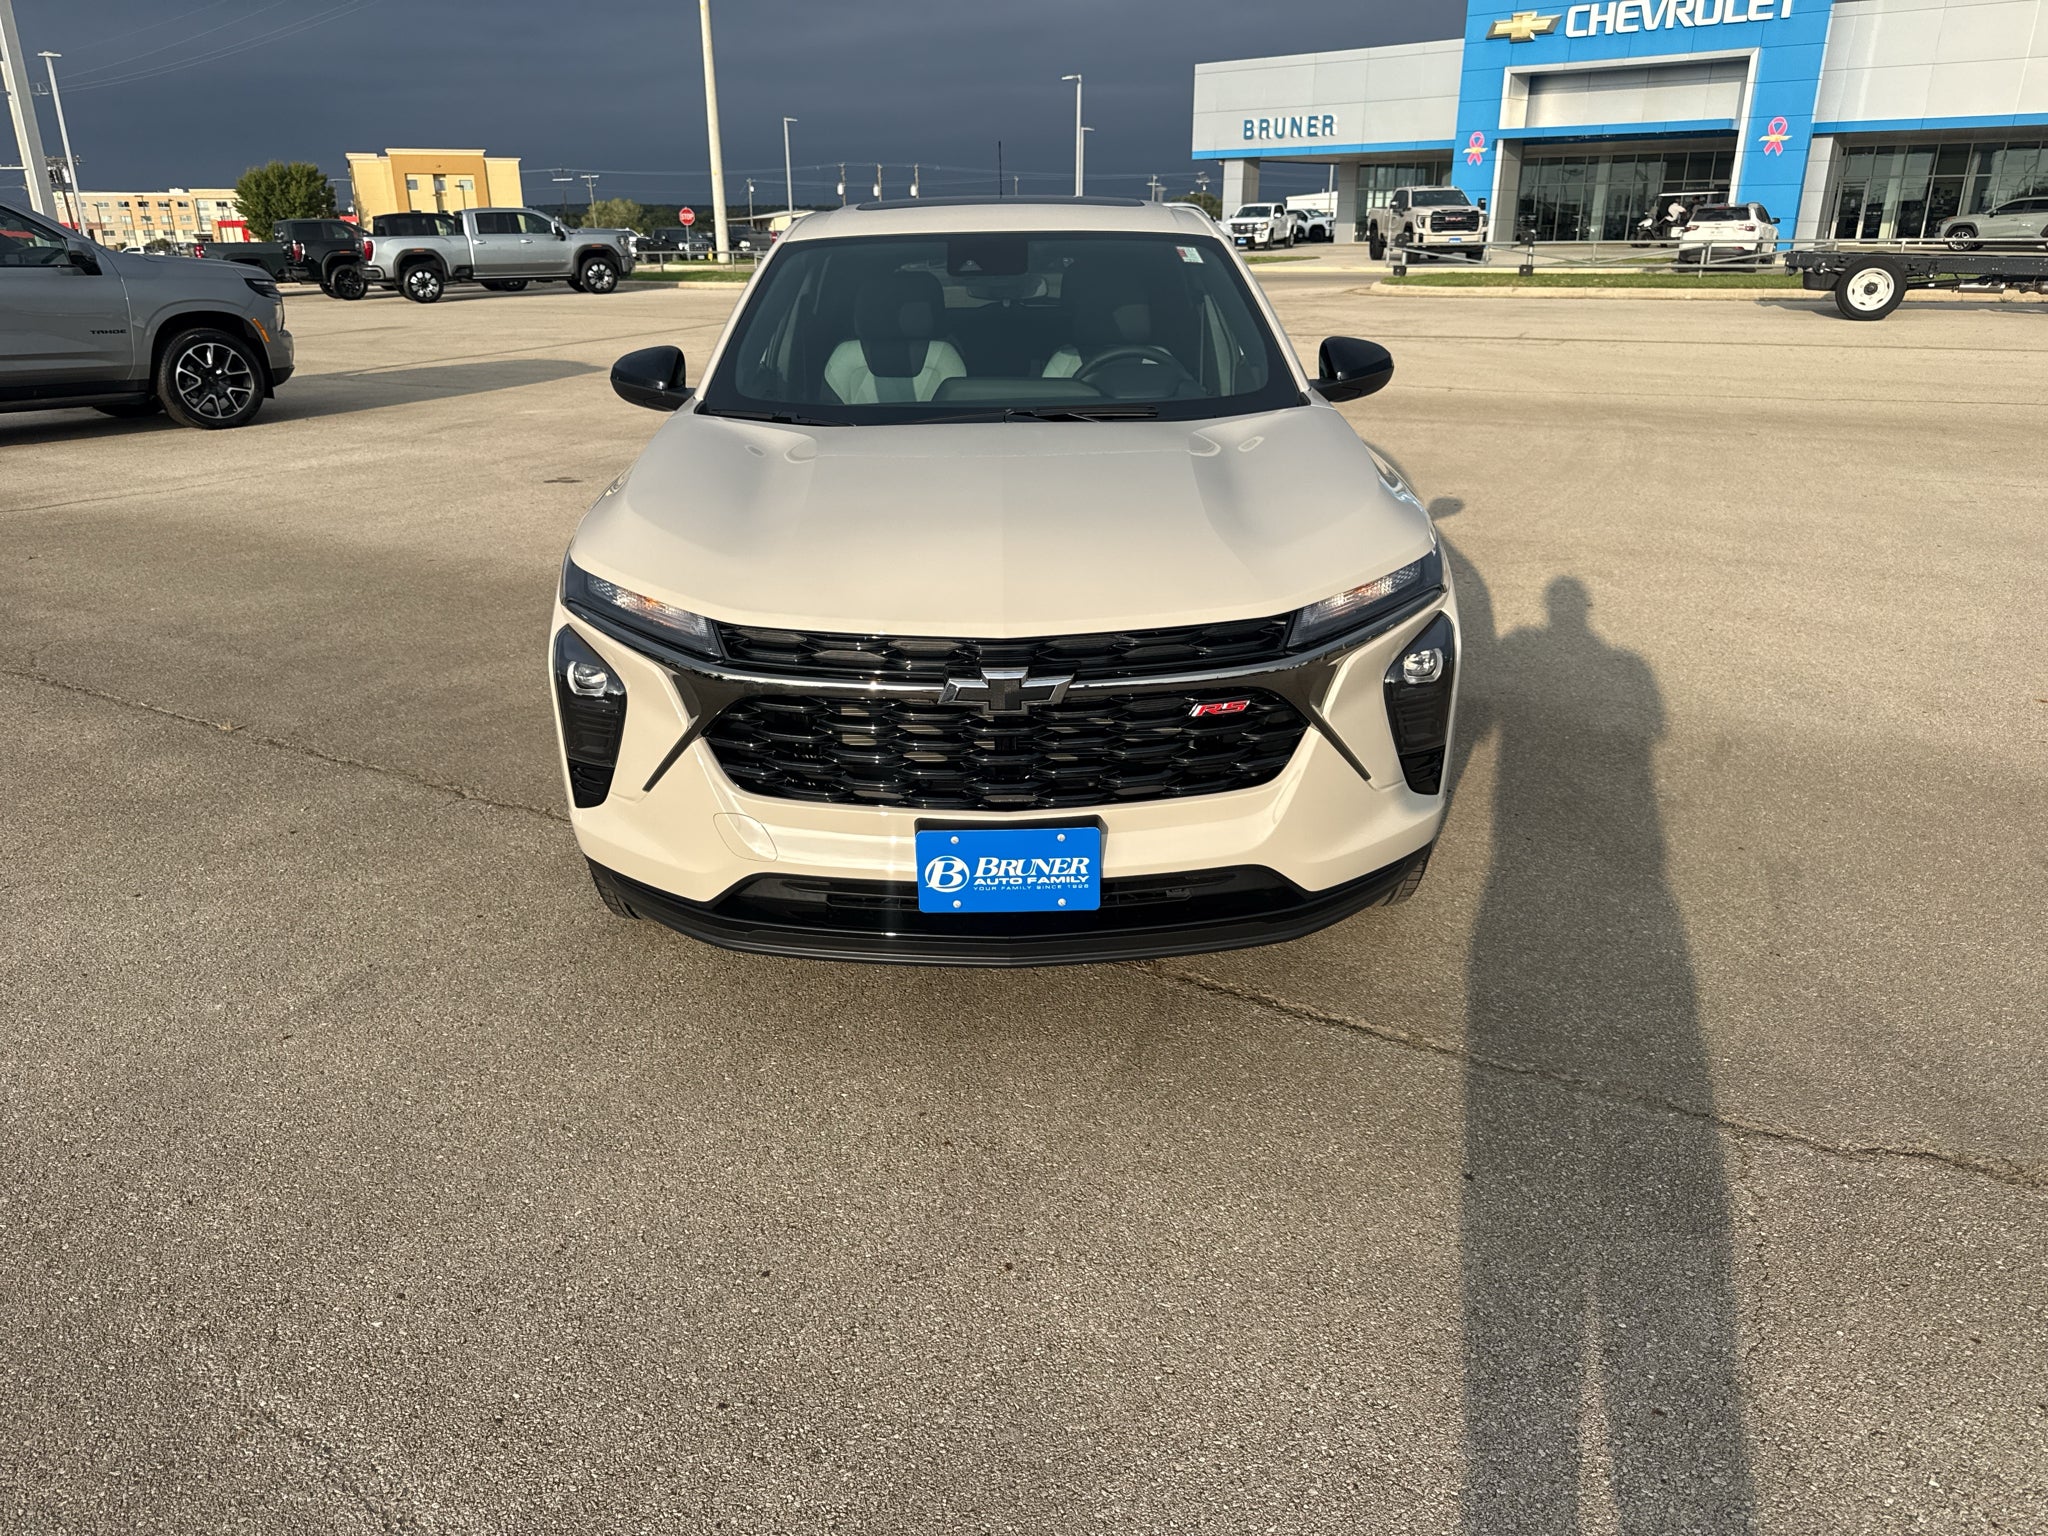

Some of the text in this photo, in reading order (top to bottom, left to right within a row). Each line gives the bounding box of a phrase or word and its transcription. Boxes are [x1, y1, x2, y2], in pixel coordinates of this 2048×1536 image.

[1565, 0, 1794, 38] CHEVROLET
[1243, 115, 1336, 140] BRUNER
[1190, 700, 1250, 717] RS
[973, 857, 1090, 878] BRUNER
[973, 875, 1090, 886] AUTO FAMILY
